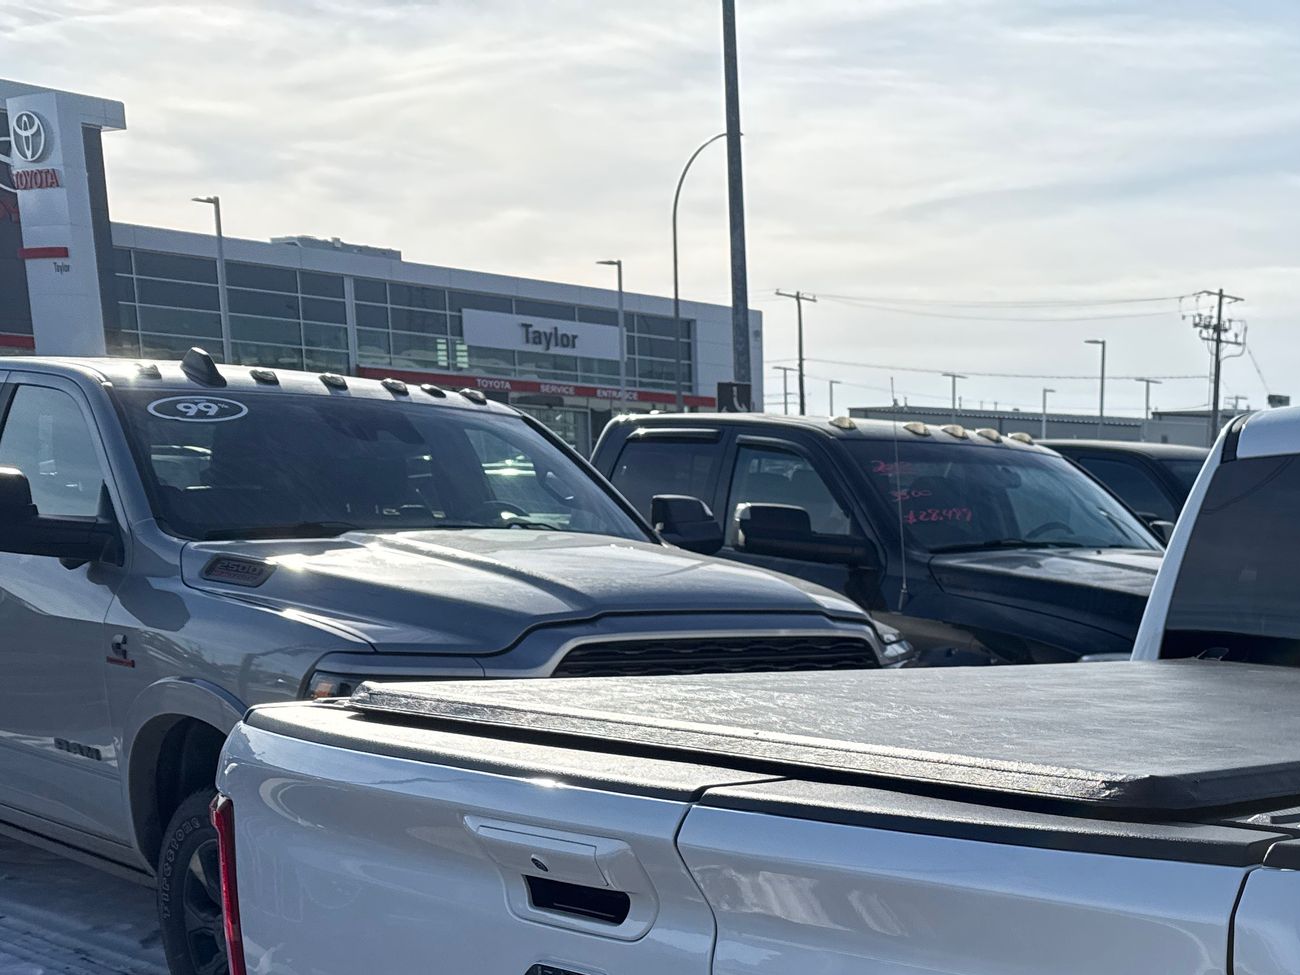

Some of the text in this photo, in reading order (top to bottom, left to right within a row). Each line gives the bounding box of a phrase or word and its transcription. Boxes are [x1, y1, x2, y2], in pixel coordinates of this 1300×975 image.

[13, 168, 60, 190] TOYOTA
[53, 262, 70, 277] Taylor
[520, 322, 578, 351] Taylor
[476, 378, 511, 391] TOYOTA
[540, 384, 575, 396] SERVICE
